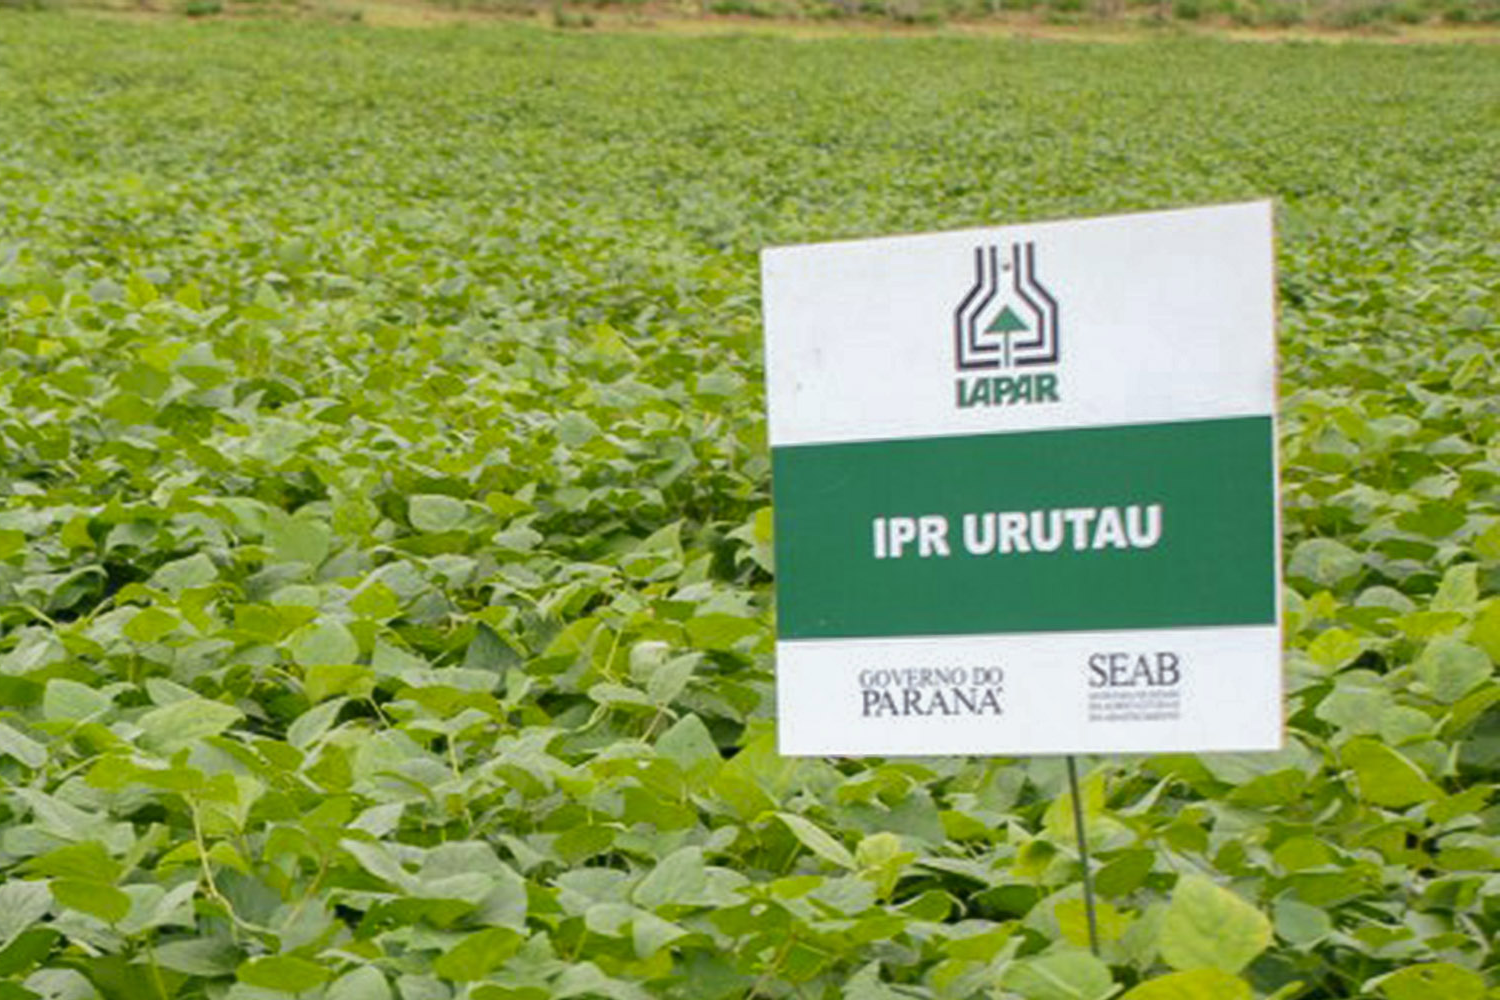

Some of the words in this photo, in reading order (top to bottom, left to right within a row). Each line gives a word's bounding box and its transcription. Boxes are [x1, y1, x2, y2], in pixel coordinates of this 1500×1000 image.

[956, 374, 1060, 408] IAPAR
[873, 516, 950, 558] IPR
[963, 504, 1162, 555] URUTAU
[858, 668, 967, 688] GOVERNO
[973, 667, 1004, 686] DO
[1088, 652, 1181, 688] SEAB
